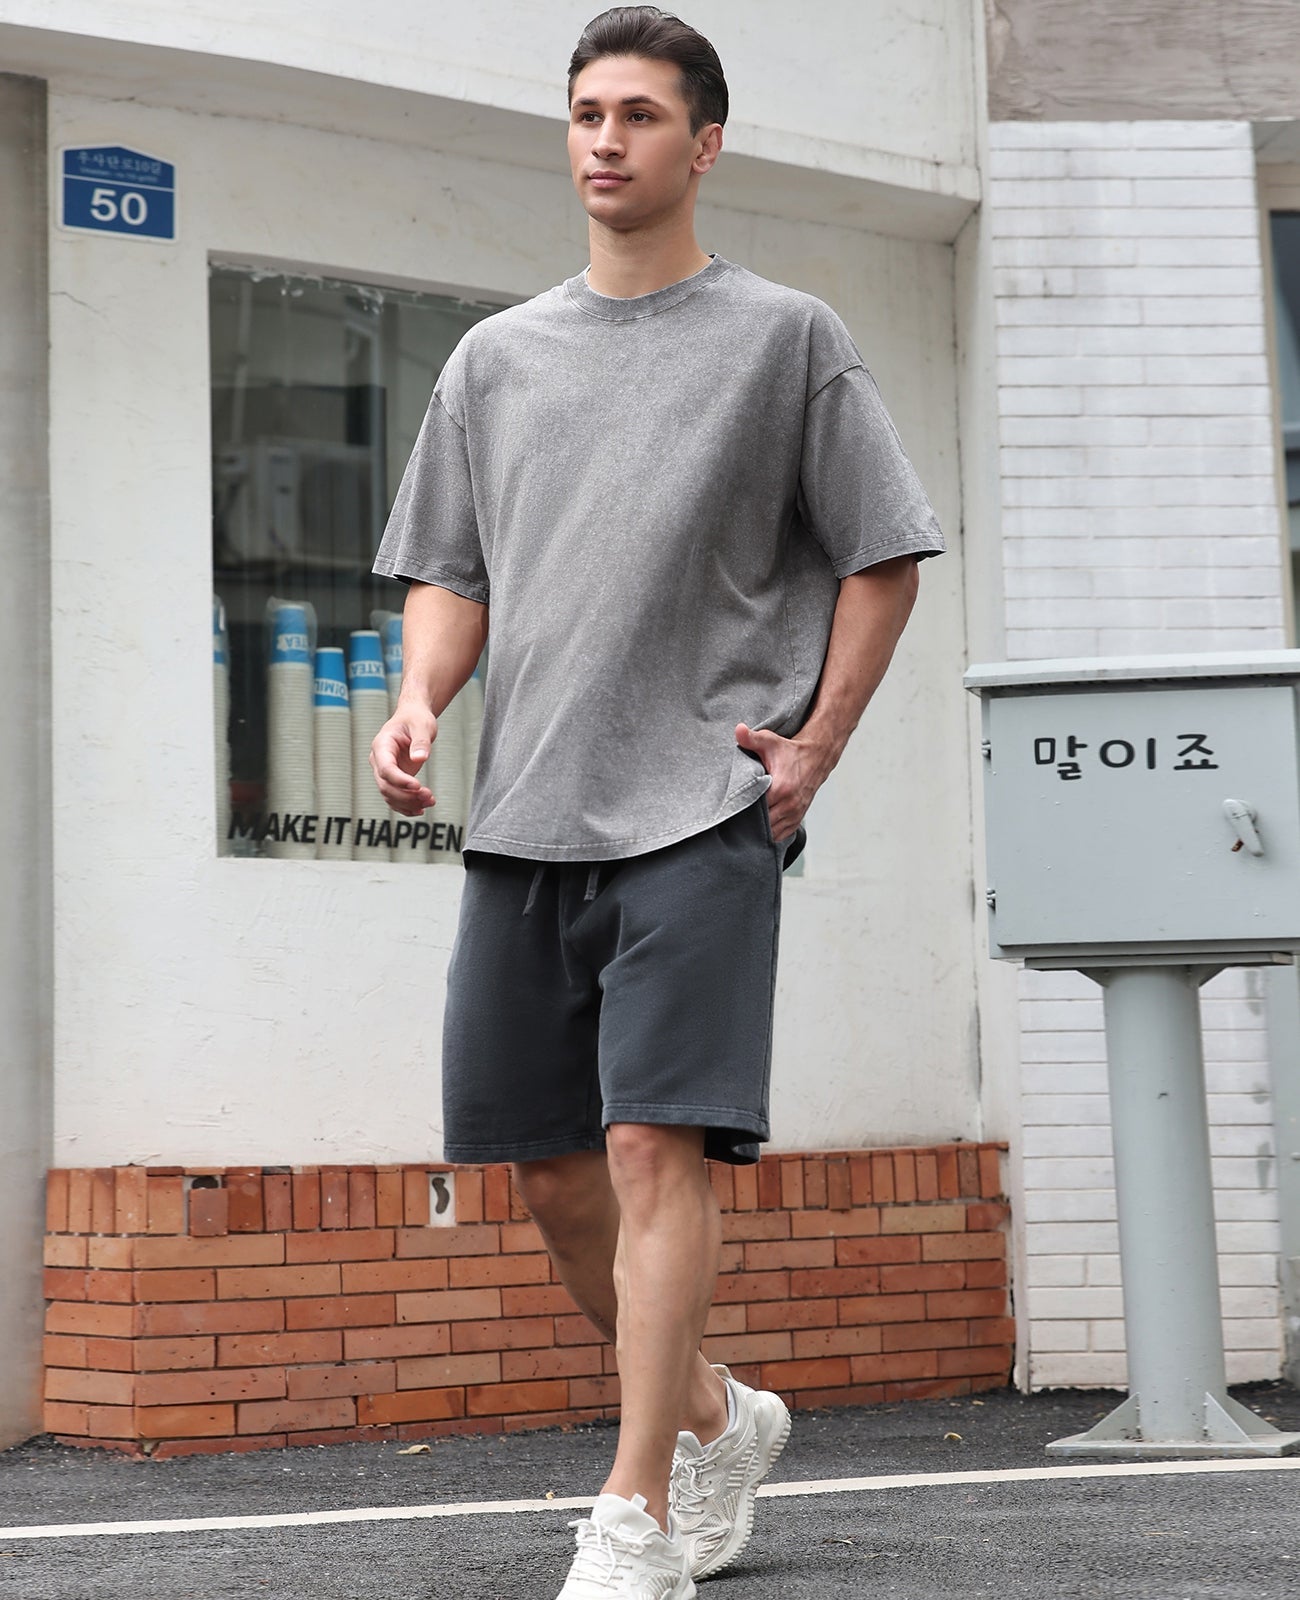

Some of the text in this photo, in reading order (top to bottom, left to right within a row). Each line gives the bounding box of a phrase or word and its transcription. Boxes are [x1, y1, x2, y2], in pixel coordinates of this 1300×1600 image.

[90, 187, 148, 226] 50
[1034, 733, 1219, 781] 말이죠
[227, 812, 463, 853] MAKE IT HAPPEN
